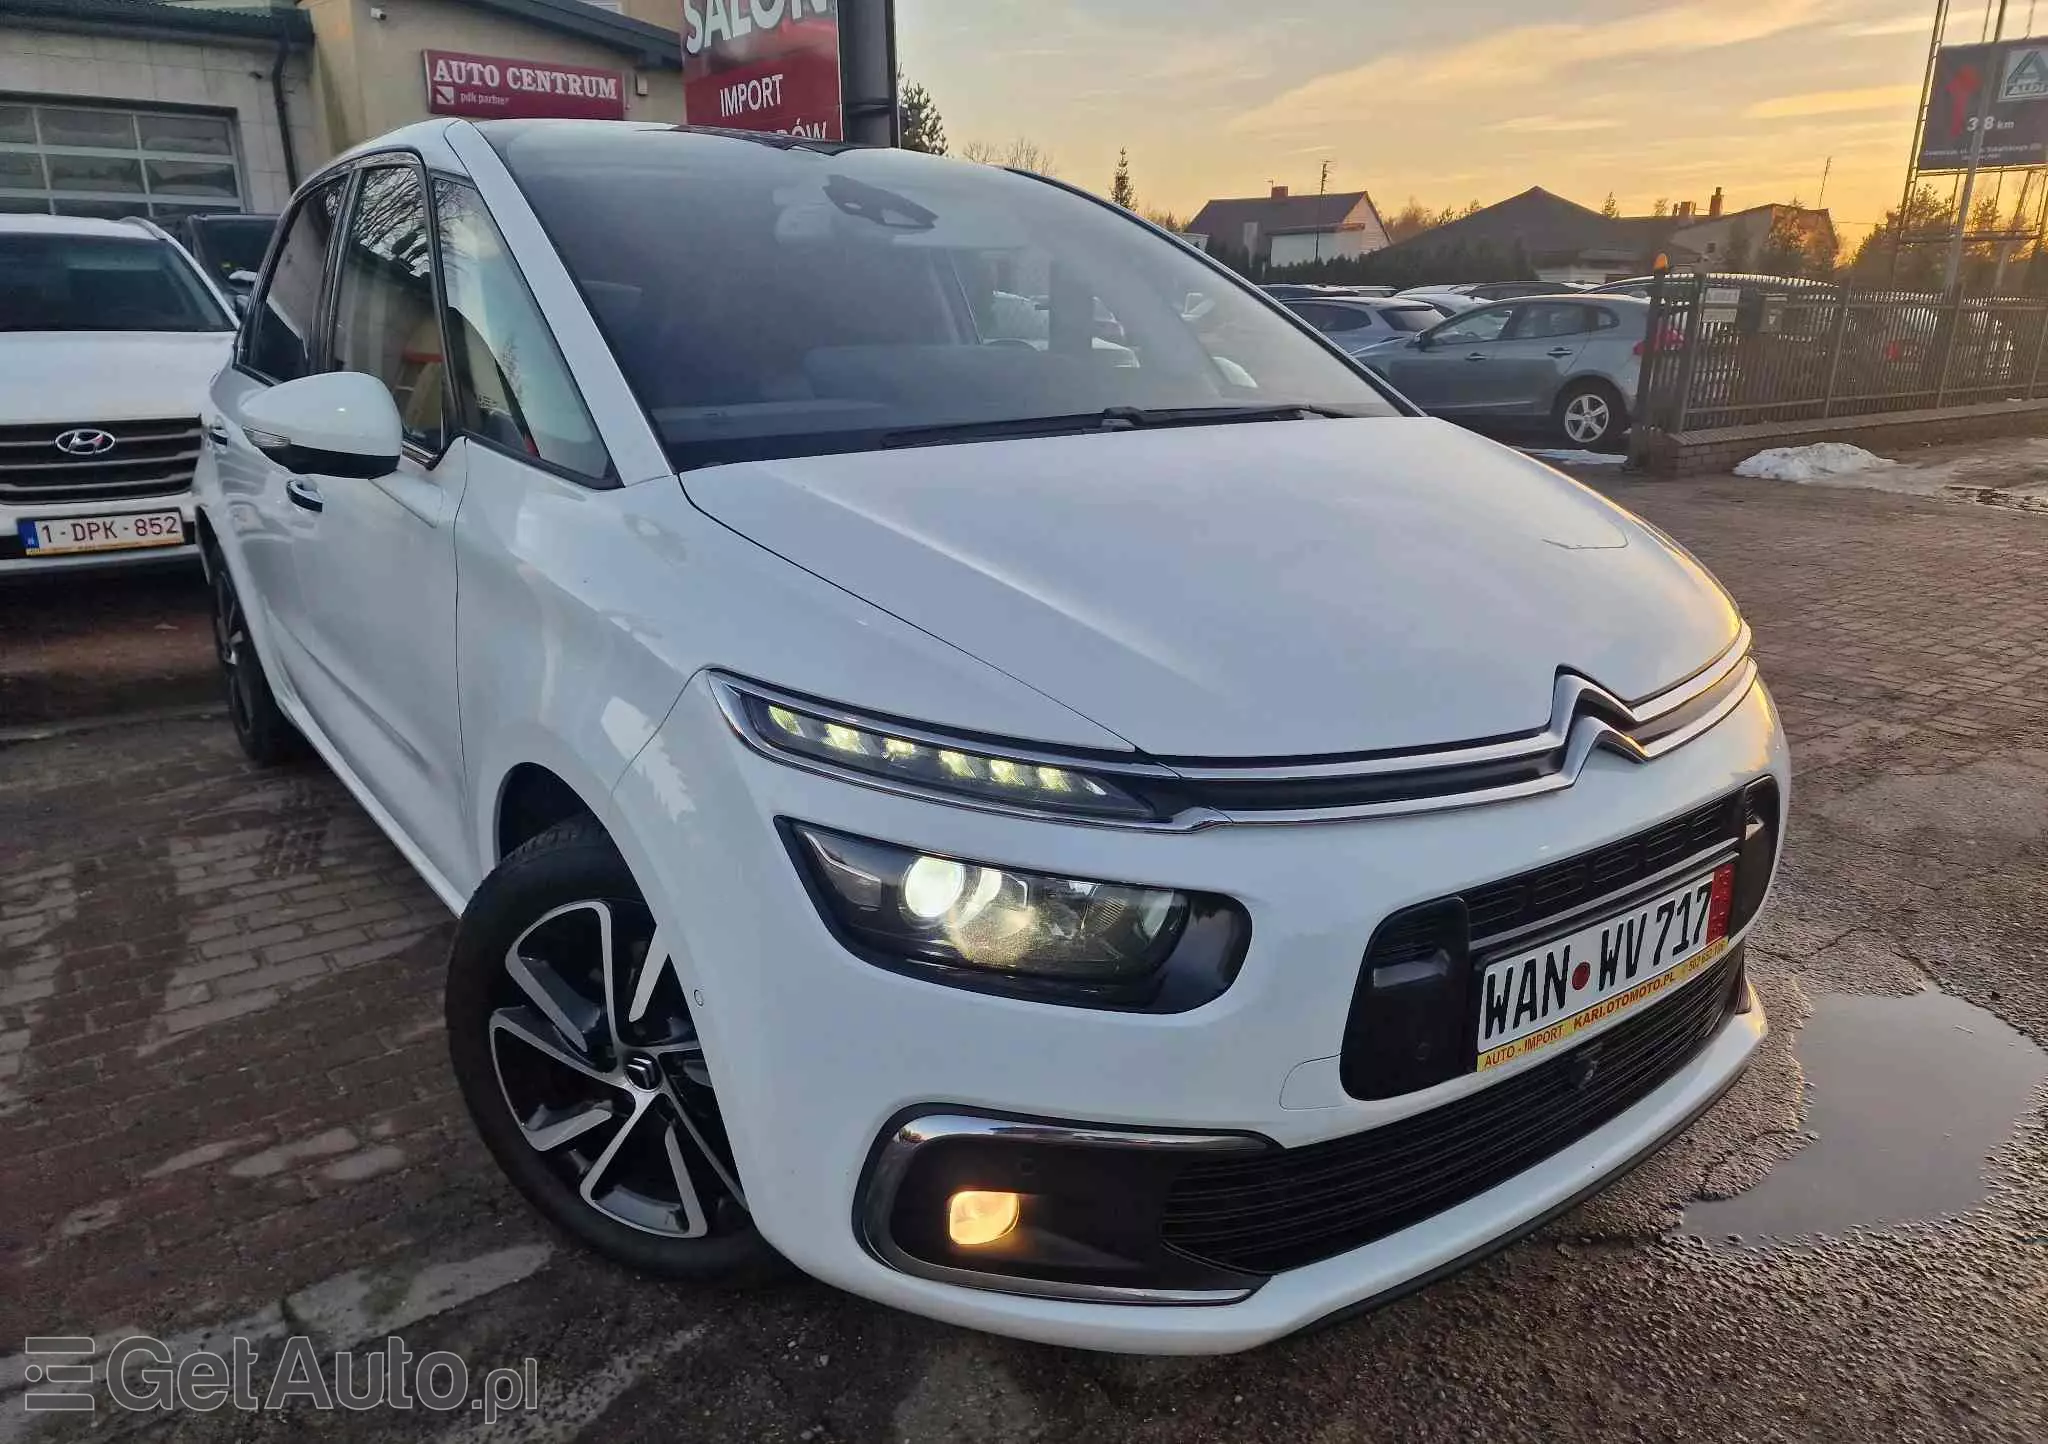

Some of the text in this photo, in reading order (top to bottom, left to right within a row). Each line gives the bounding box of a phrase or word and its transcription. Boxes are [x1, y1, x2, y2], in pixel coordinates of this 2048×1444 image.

[433, 59, 617, 100] AUTO CENTRUM
[719, 73, 784, 118] IMPORT
[1997, 120, 2015, 130] km
[1484, 945, 1570, 1040] WAN
[1599, 912, 1648, 992] WV
[1652, 880, 1713, 966] 717
[1484, 1045, 1515, 1068] AUTO
[1524, 1024, 1564, 1052] IMPORT
